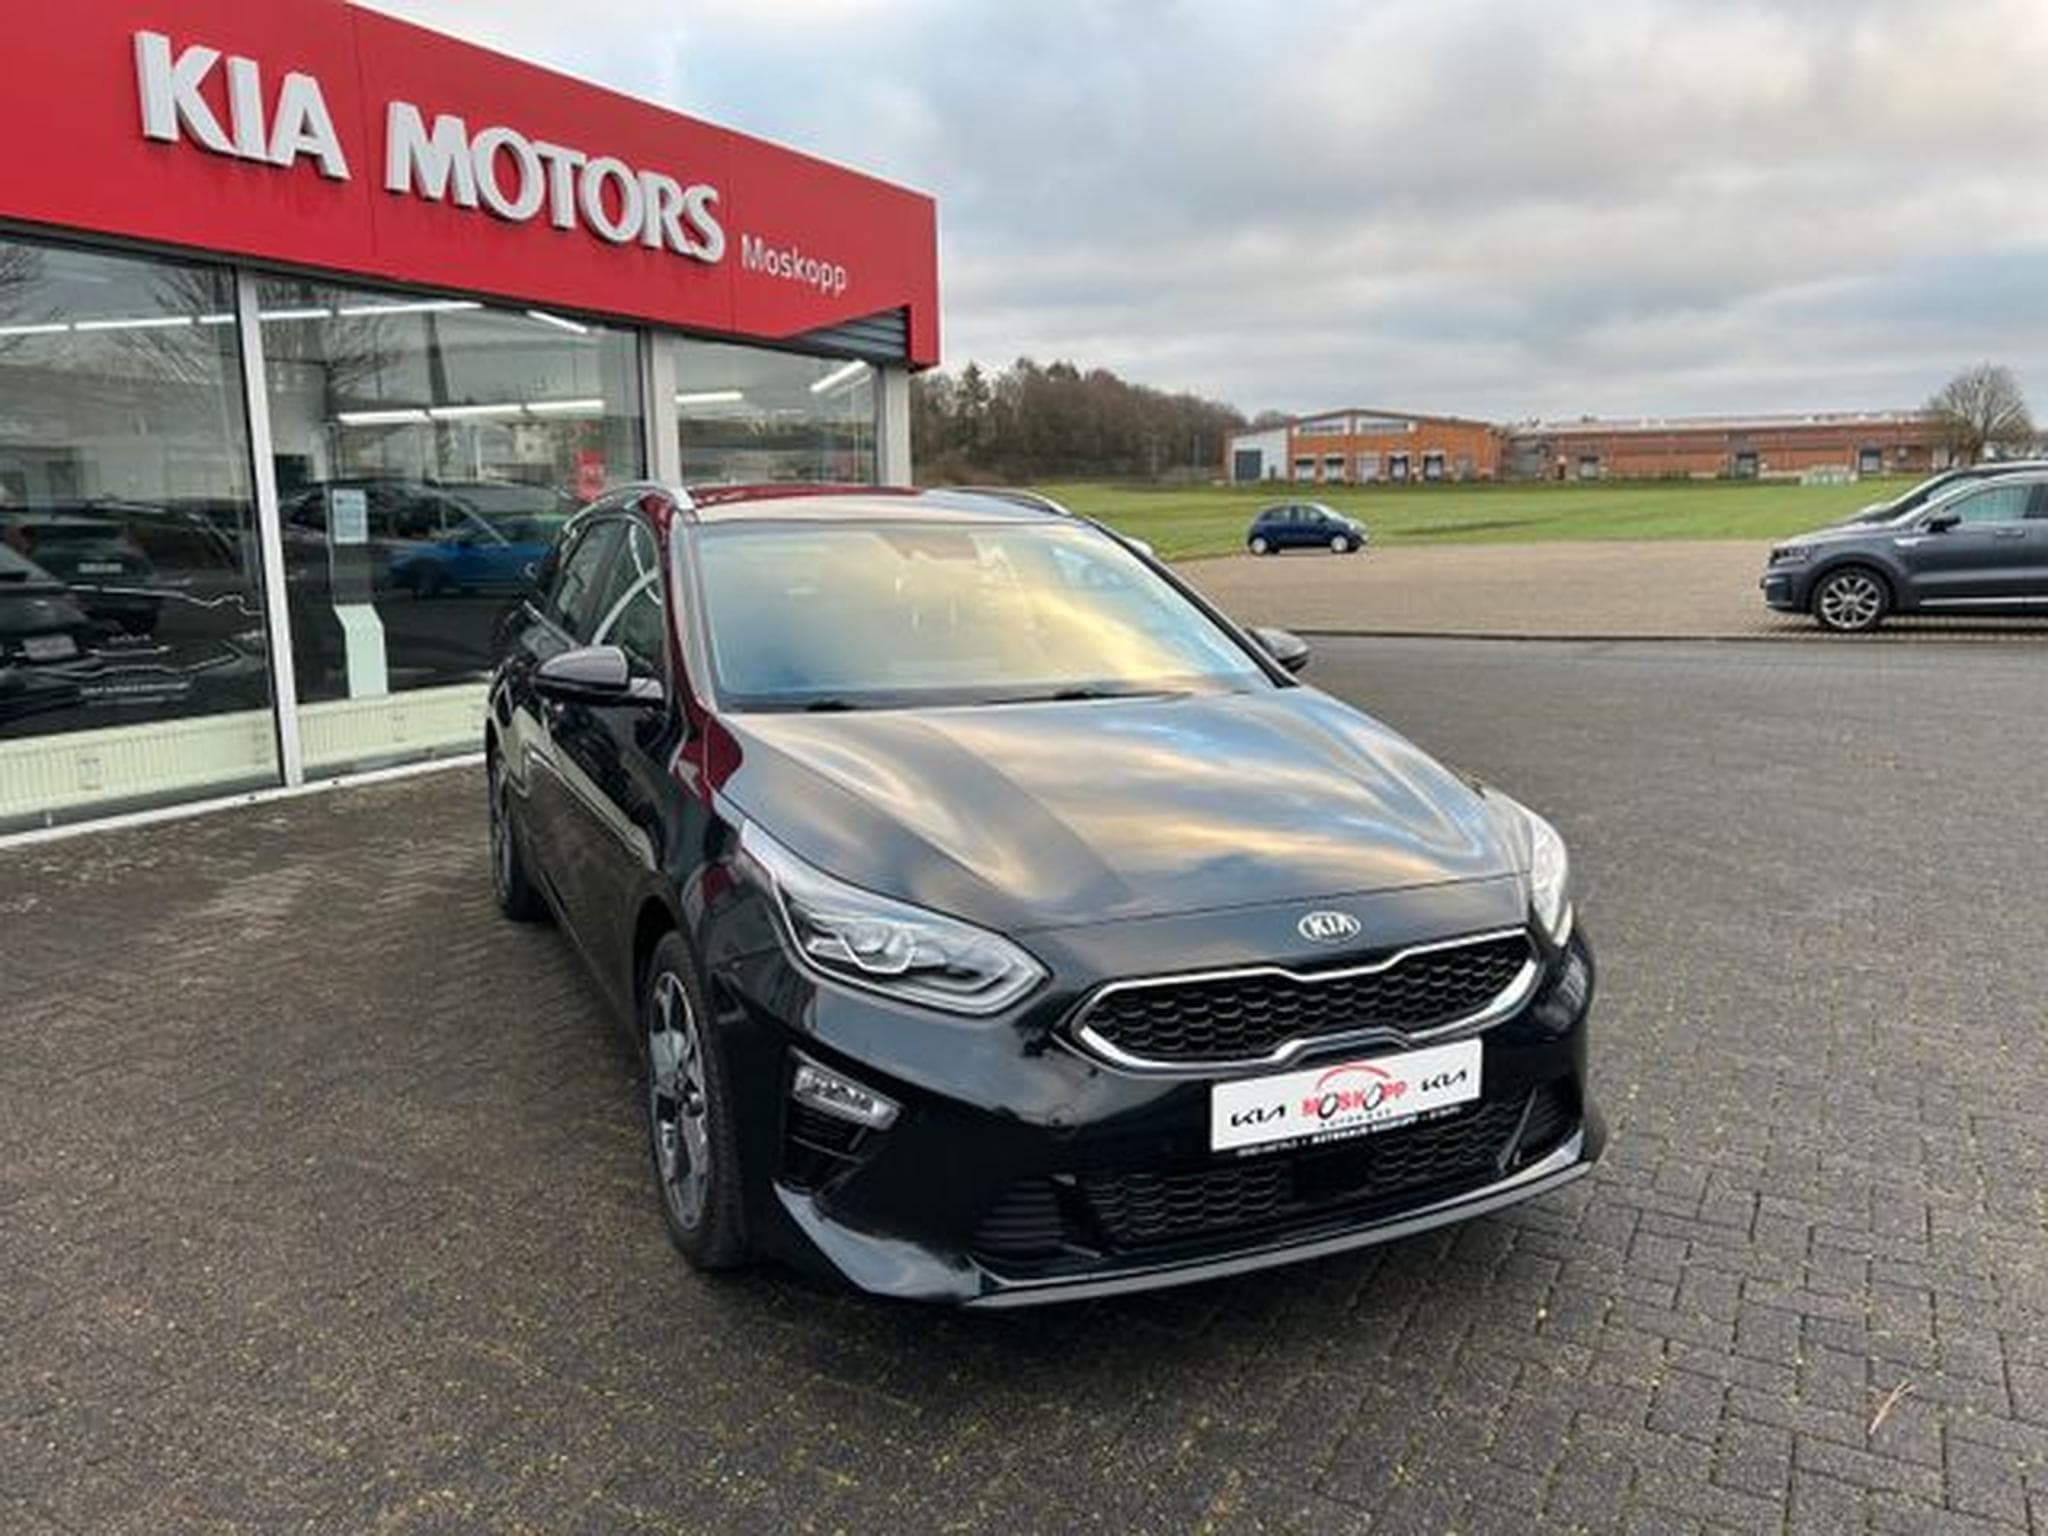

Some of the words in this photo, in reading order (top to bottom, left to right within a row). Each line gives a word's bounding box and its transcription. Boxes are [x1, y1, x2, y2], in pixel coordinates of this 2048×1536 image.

[134, 30, 351, 181] KIA
[385, 100, 726, 265] MOTORS
[741, 233, 847, 299] Moskopp
[1304, 914, 1356, 937] KIA
